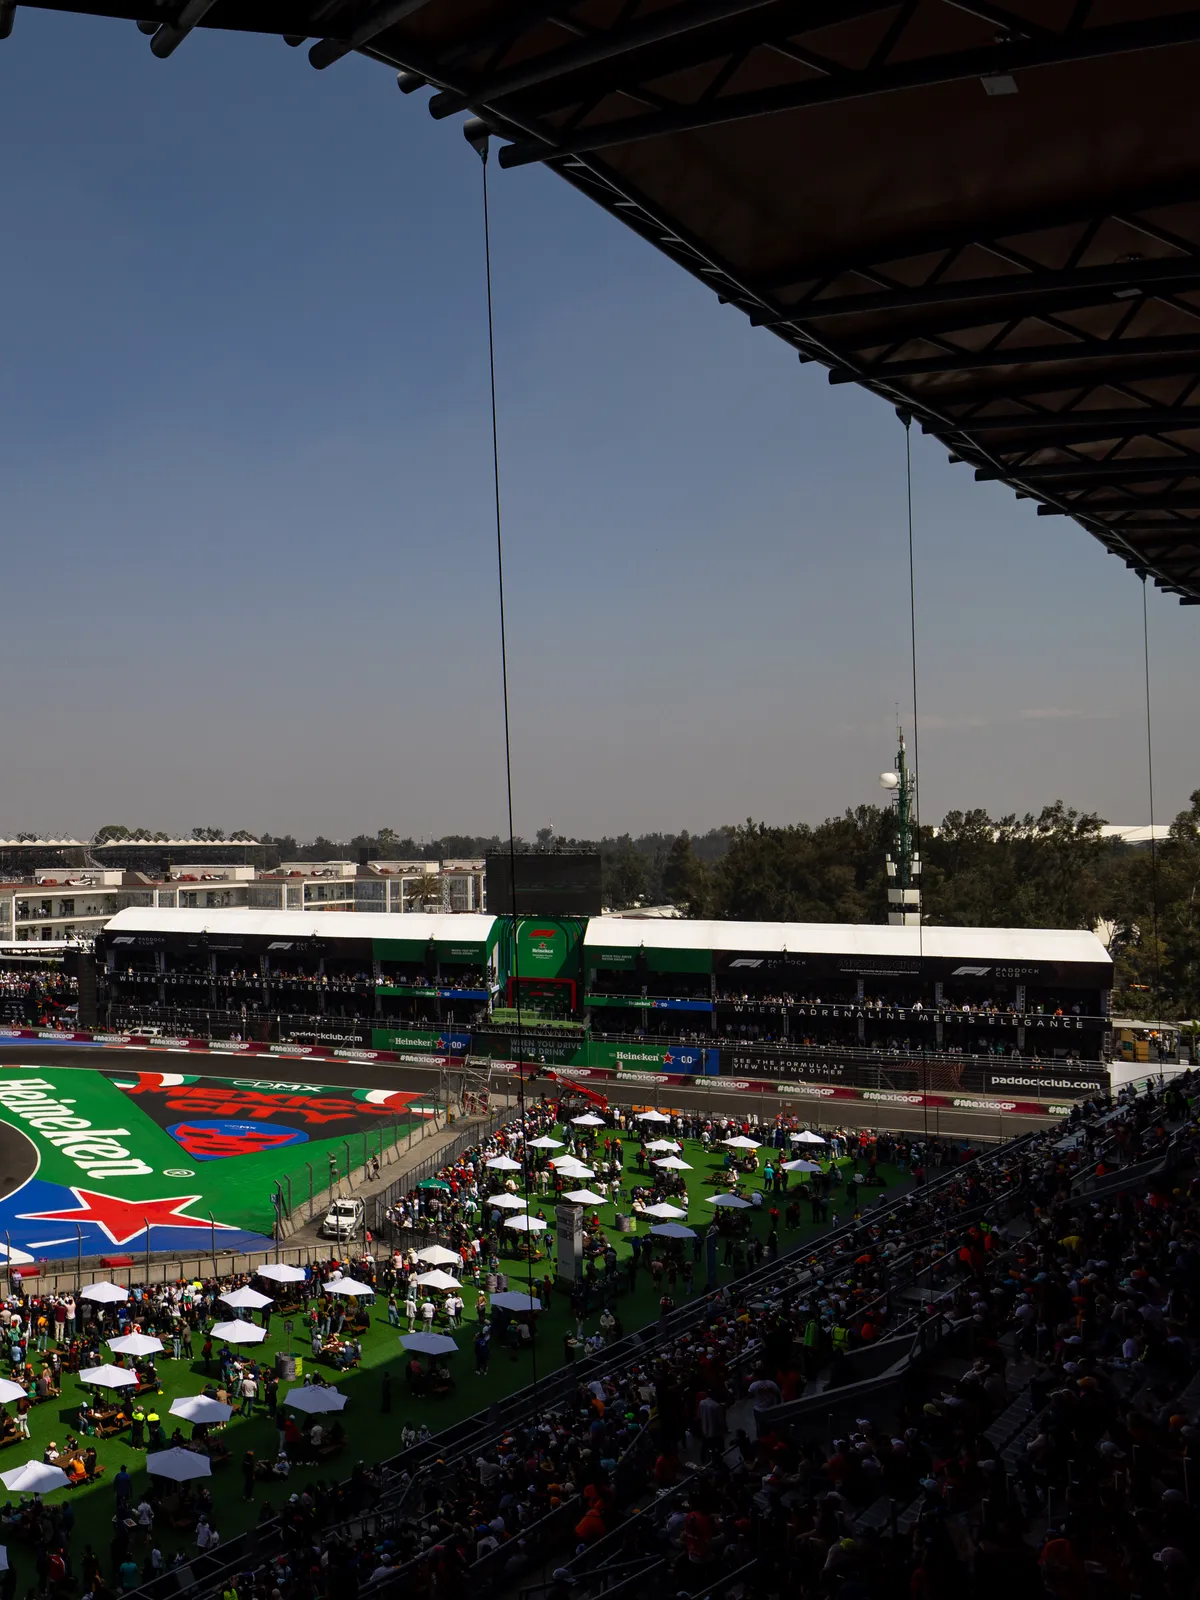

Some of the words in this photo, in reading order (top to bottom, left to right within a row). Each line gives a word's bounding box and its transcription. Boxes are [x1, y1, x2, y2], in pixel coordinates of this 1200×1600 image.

[120, 975, 157, 983] WHERE
[163, 979, 237, 987] ADRENALINE
[244, 981, 285, 989] MEETS
[291, 984, 356, 993] ELEGANCE
[734, 1005, 787, 1015] WHERE
[799, 1008, 906, 1020] ADRENALINE
[919, 1014, 974, 1024] MEETS
[989, 1017, 1083, 1029] ELEGANCE
[290, 1030, 363, 1043] paddockclub.com
[395, 1037, 432, 1047] Heineken
[510, 1039, 535, 1048] WHEN
[538, 1040, 555, 1048] YOU
[557, 1041, 583, 1050] DRIVE
[334, 1049, 377, 1060] #MexicoGP
[510, 1045, 537, 1055] NEVER
[539, 1047, 566, 1057] DRINK
[616, 1051, 660, 1062] Heineken
[400, 1054, 446, 1065] #MexicoGP
[680, 1055, 693, 1064] 0.0
[781, 1060, 828, 1069] FORMULA
[617, 1072, 669, 1083] #MexicoGP
[809, 1068, 843, 1076] OTHER
[232, 1080, 324, 1093] CDMX
[695, 1076, 750, 1089] #MexicoGP
[992, 1075, 1101, 1090] paddockclub.com
[777, 1085, 834, 1097] #MexicoGP
[863, 1090, 922, 1103] #MexicoGP
[128, 1084, 412, 1117] MEXICO
[953, 1099, 1016, 1111] #MexicoGP
[165, 1099, 358, 1125] CITY
[224, 1123, 257, 1131] CDMX
